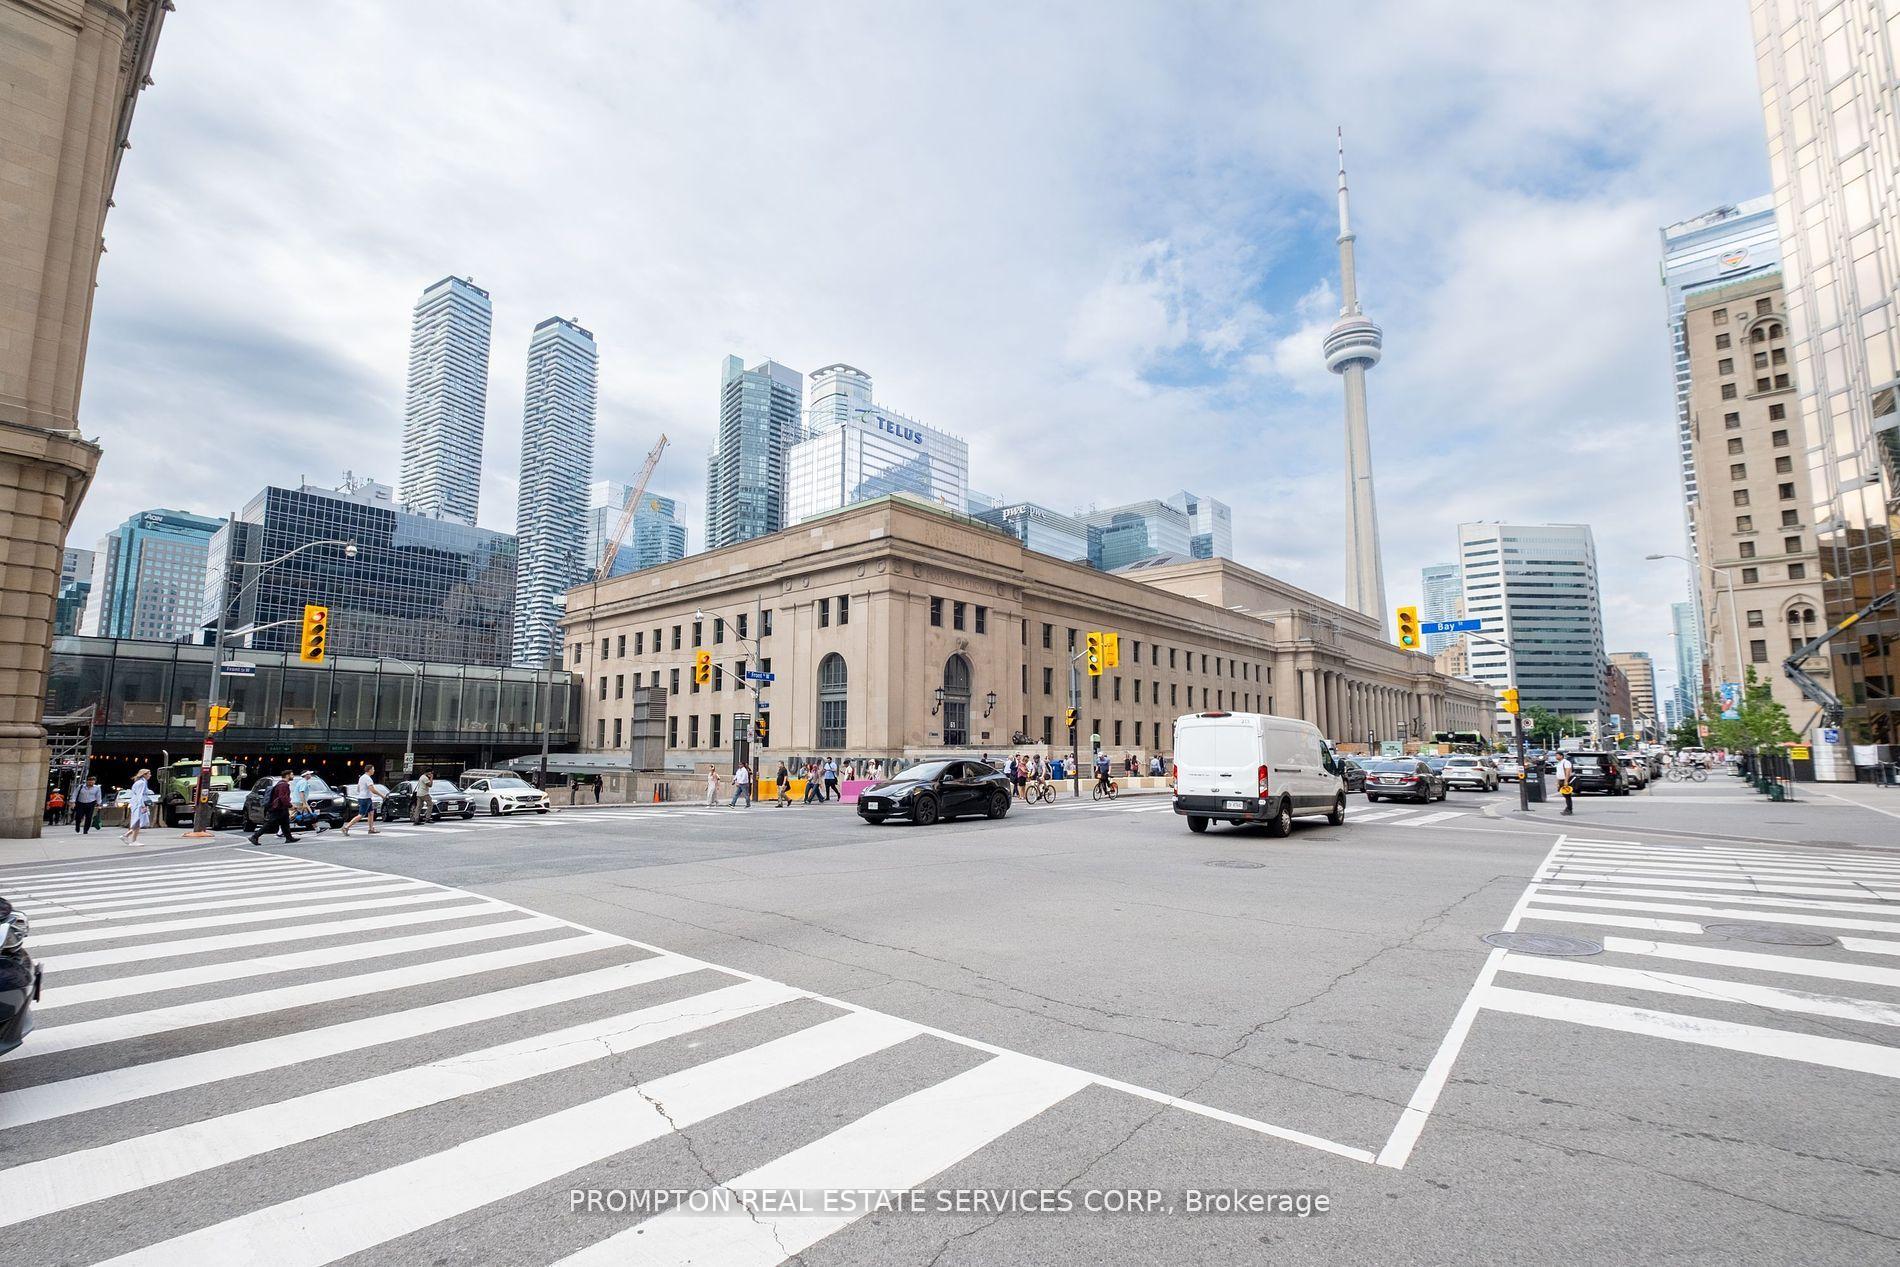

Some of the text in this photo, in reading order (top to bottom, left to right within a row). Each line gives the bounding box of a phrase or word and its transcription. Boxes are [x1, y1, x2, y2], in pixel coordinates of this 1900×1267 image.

[877, 416, 923, 445] TELUS
[1002, 505, 1027, 521] pwc
[1437, 622, 1455, 632] Bay
